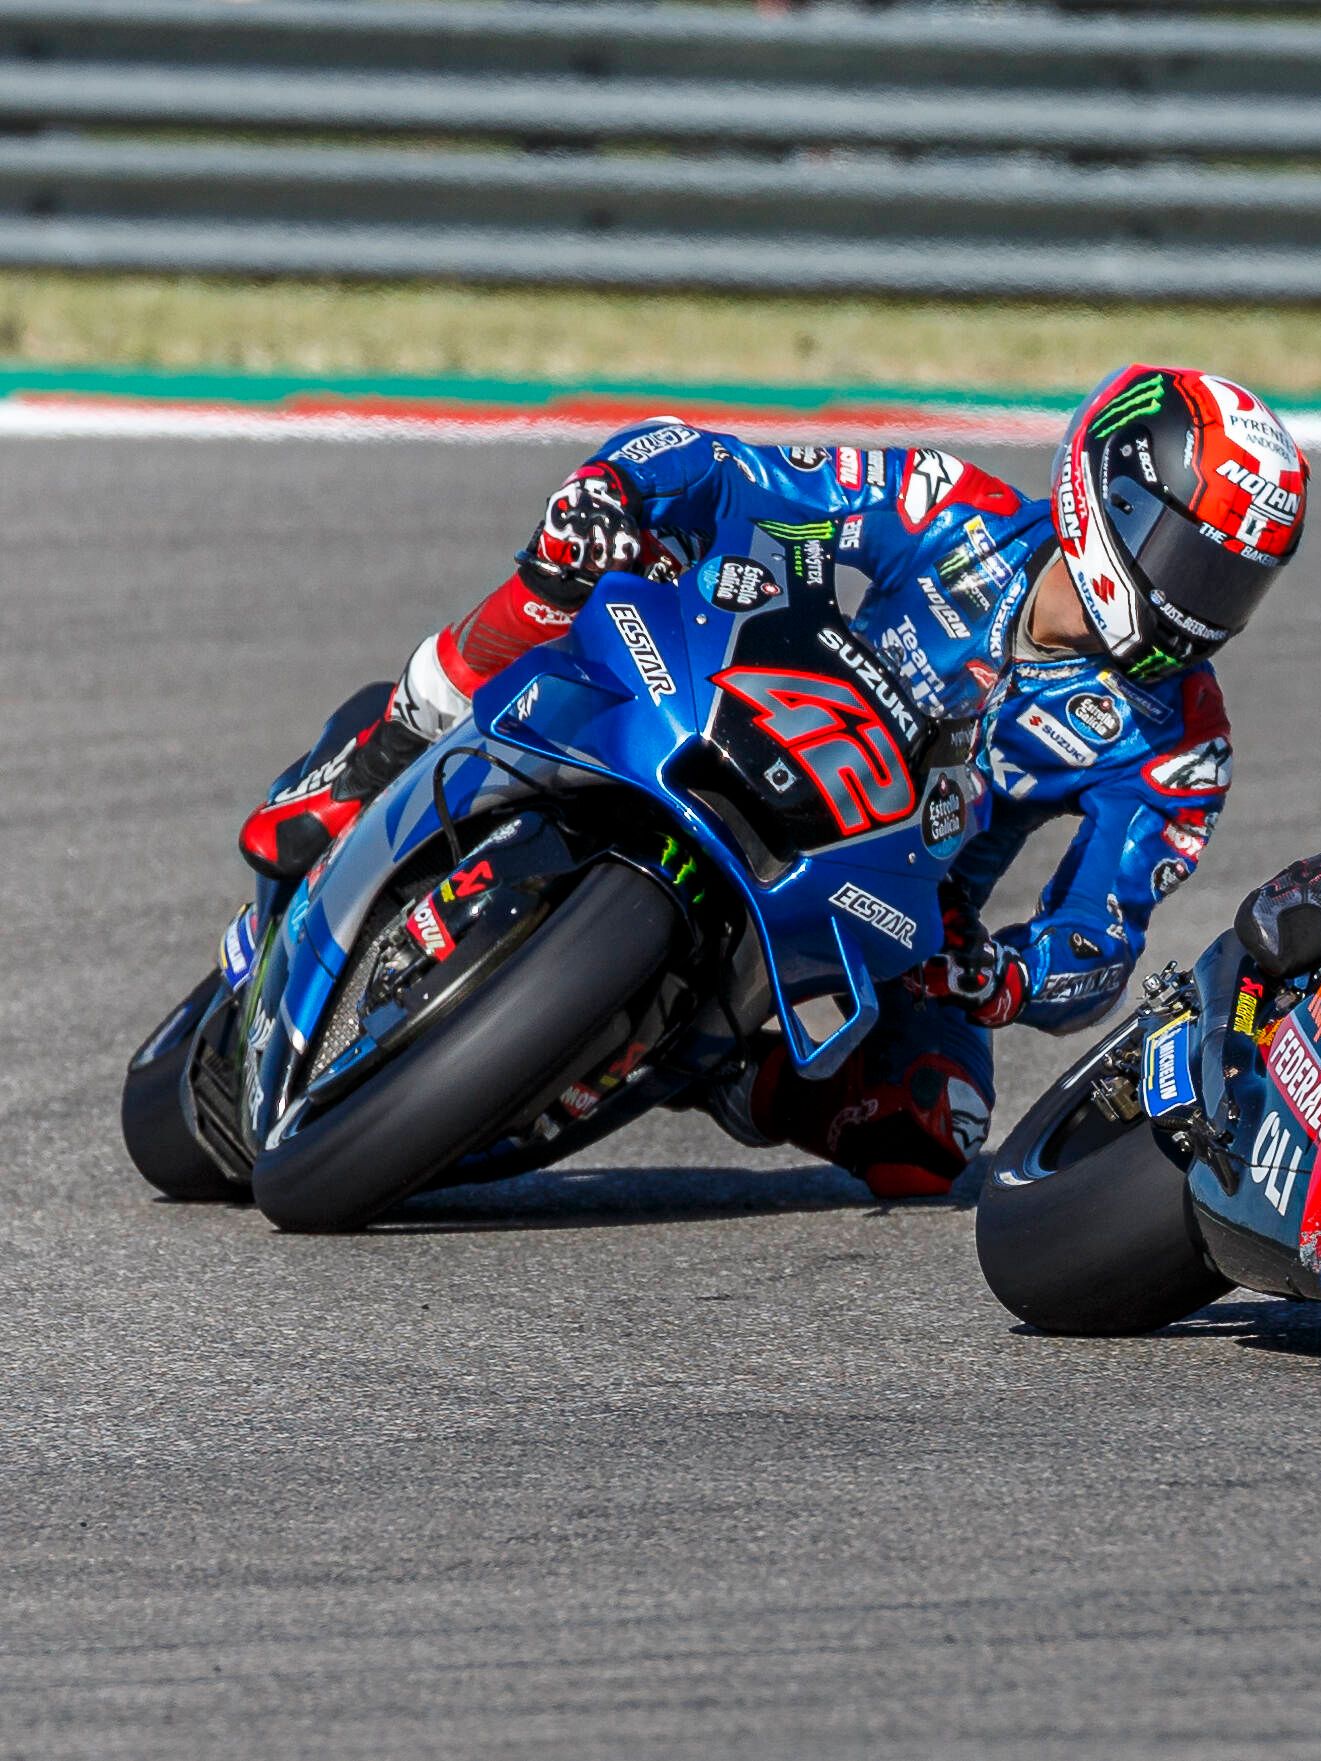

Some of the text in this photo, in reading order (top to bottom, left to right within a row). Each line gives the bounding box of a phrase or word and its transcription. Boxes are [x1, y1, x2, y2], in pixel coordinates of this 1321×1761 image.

[1216, 459, 1300, 526] NOLAN
[1199, 521, 1227, 545] THE
[717, 562, 740, 600] Galicia
[737, 564, 763, 604] Estrella
[917, 577, 971, 640] NOLAN
[1077, 571, 1108, 631] SUZUKI
[606, 603, 676, 706] ECSTAR
[817, 628, 918, 741] SUZUKI
[902, 615, 945, 692] Team
[709, 666, 916, 837] 42
[1041, 724, 1087, 763] SUZUKI
[829, 882, 917, 949] ECSTAR
[1159, 1038, 1178, 1100] MICHELIN
